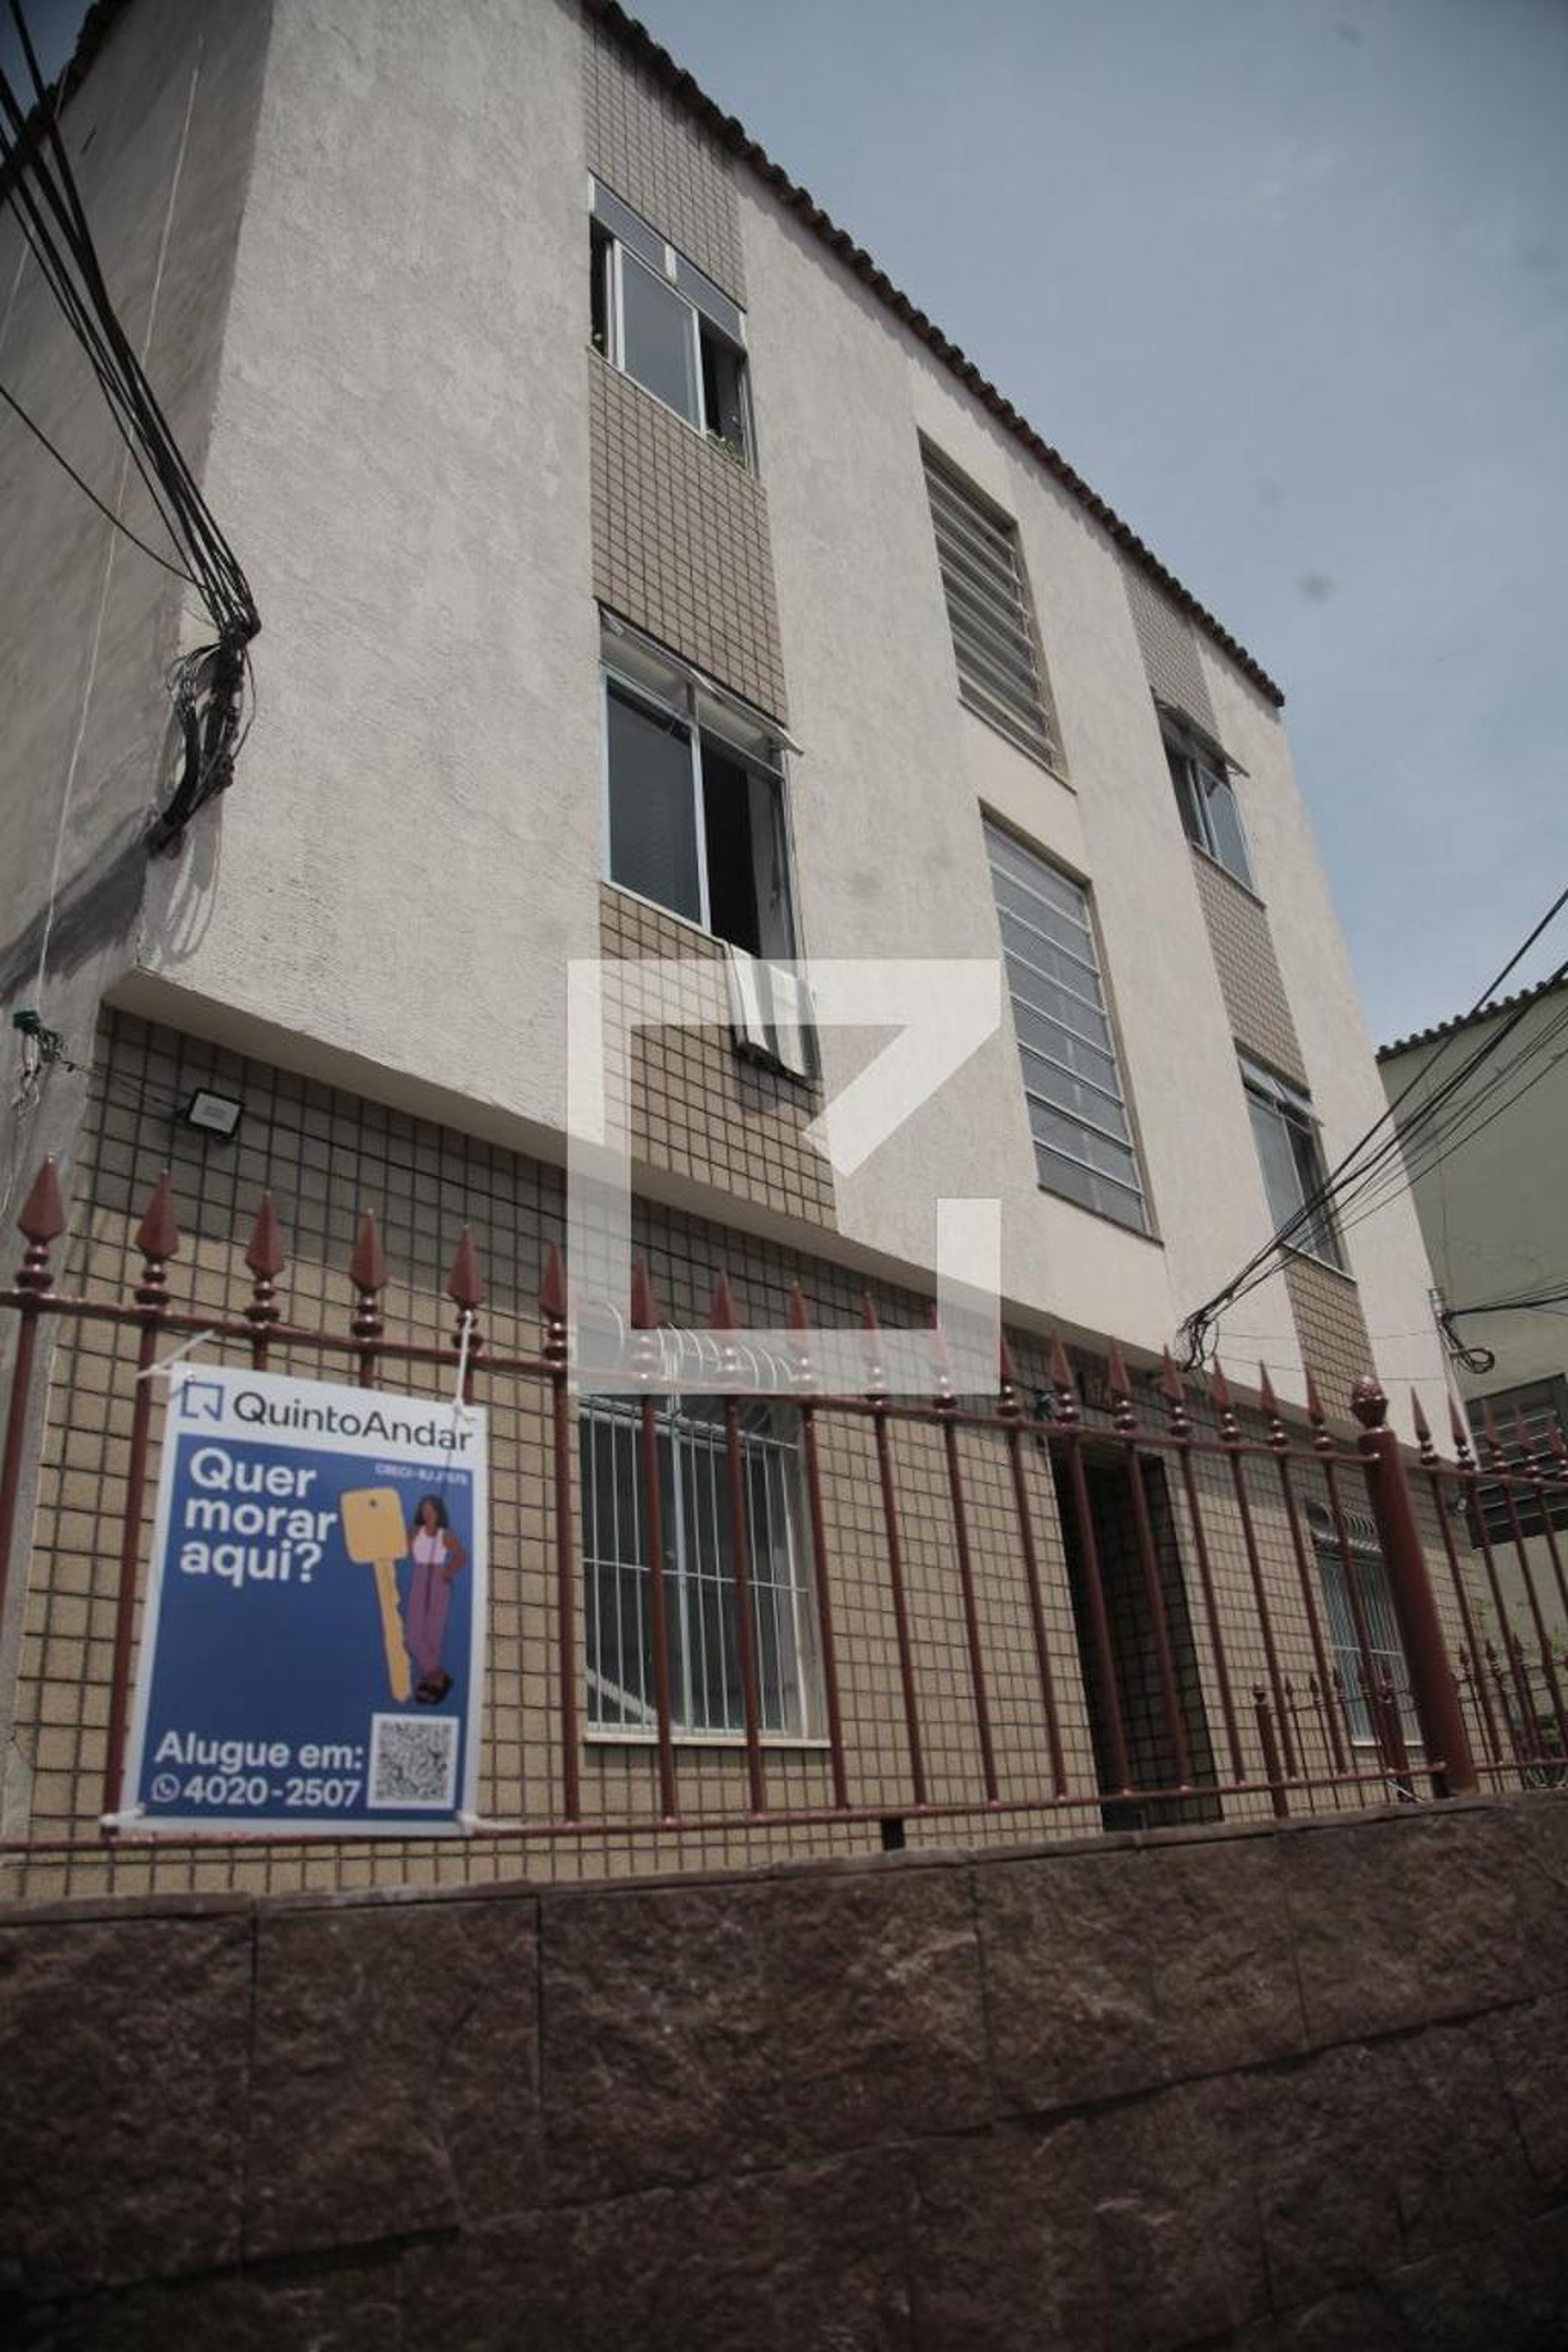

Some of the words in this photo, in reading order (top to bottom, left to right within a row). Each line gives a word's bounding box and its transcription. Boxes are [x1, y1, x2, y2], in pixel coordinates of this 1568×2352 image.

[234, 1392, 473, 1451] QuintoAndar
[190, 1448, 317, 1498] Quer
[185, 1498, 337, 1541] morar
[180, 1540, 322, 1588] aqui?
[155, 1731, 289, 1773] Alugue
[299, 1744, 363, 1769] em:
